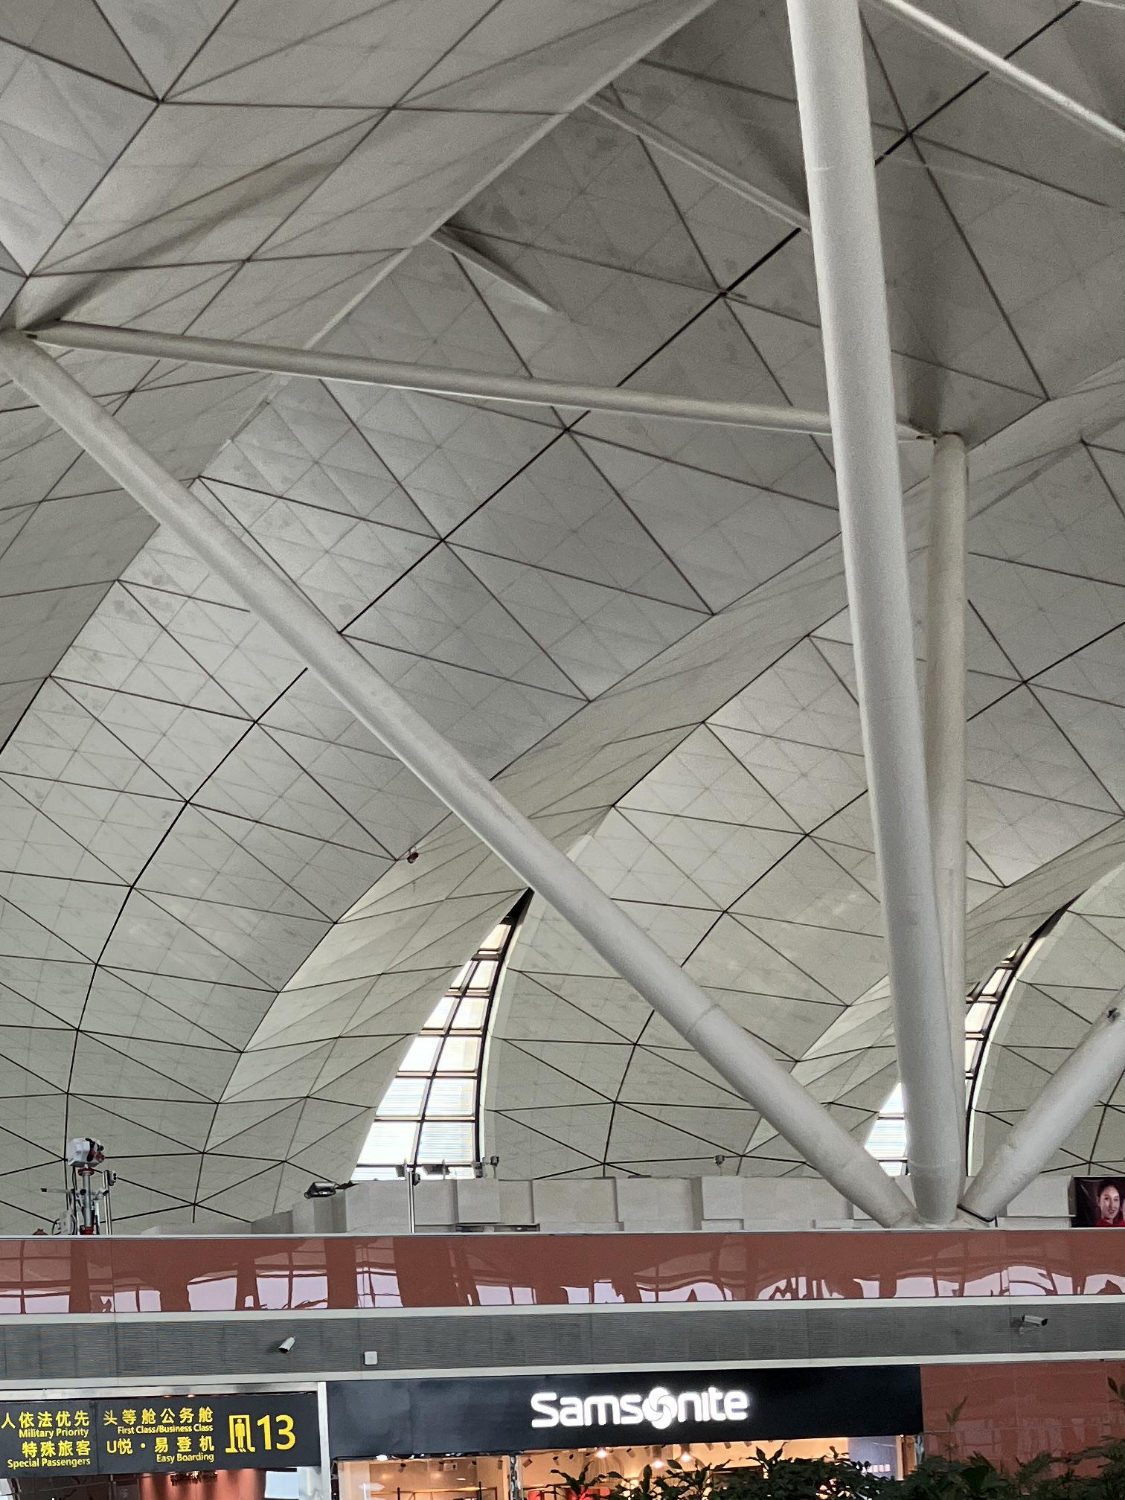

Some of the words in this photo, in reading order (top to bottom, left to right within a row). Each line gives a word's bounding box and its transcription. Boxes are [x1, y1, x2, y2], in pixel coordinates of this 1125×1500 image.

[531, 1387, 748, 1429] Samsonite
[103, 1406, 213, 1426] 头等舱公务舱
[18, 1428, 54, 1439] Military
[56, 1427, 89, 1438] Priority
[117, 1426, 135, 1435] First
[193, 1423, 213, 1432] Class
[257, 1414, 296, 1451] 13
[22, 1440, 91, 1458] 特殊旅客
[7, 1459, 40, 1469] Special
[41, 1457, 91, 1468] Passengers
[156, 1454, 175, 1464] Easy
[176, 1452, 215, 1463] Boarding
